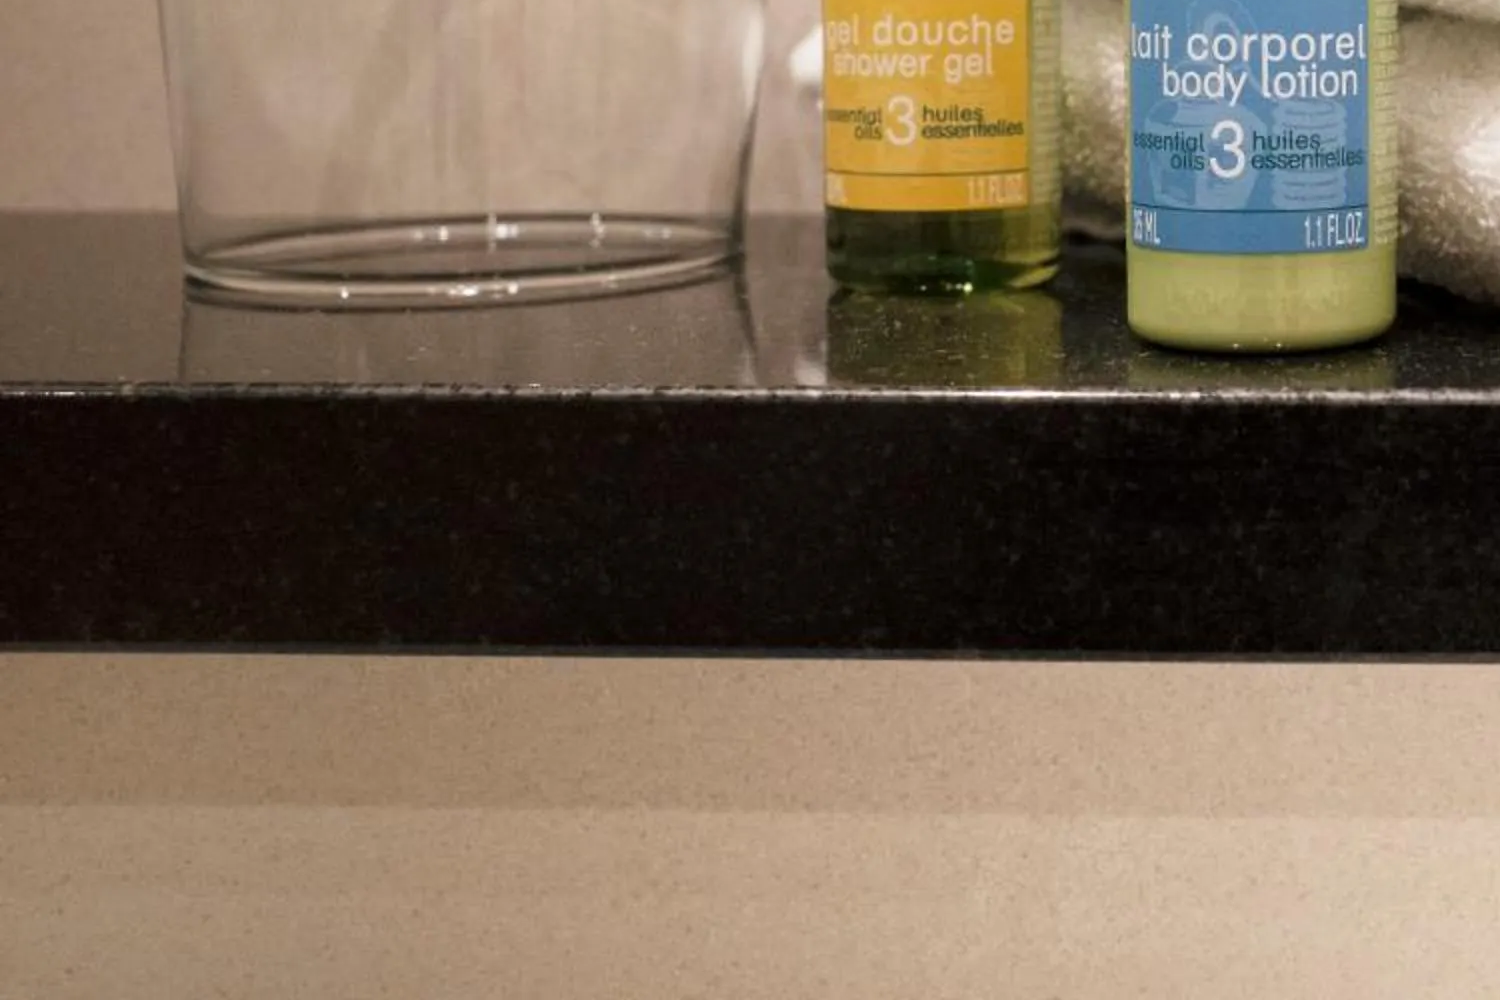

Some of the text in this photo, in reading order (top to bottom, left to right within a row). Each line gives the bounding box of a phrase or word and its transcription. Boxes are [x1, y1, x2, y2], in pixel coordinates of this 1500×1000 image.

[872, 13, 1015, 46] douche
[1132, 23, 1367, 69] lait corporel
[833, 47, 993, 84] shower gel
[1162, 63, 1358, 107] body lotion
[886, 94, 917, 146] 3
[922, 104, 984, 123] huiles
[1208, 119, 1247, 179] 3
[1252, 130, 1321, 150] huiles
[1170, 151, 1206, 170] oils
[1251, 147, 1364, 171] essentielles
[1304, 214, 1323, 248] 1.1
